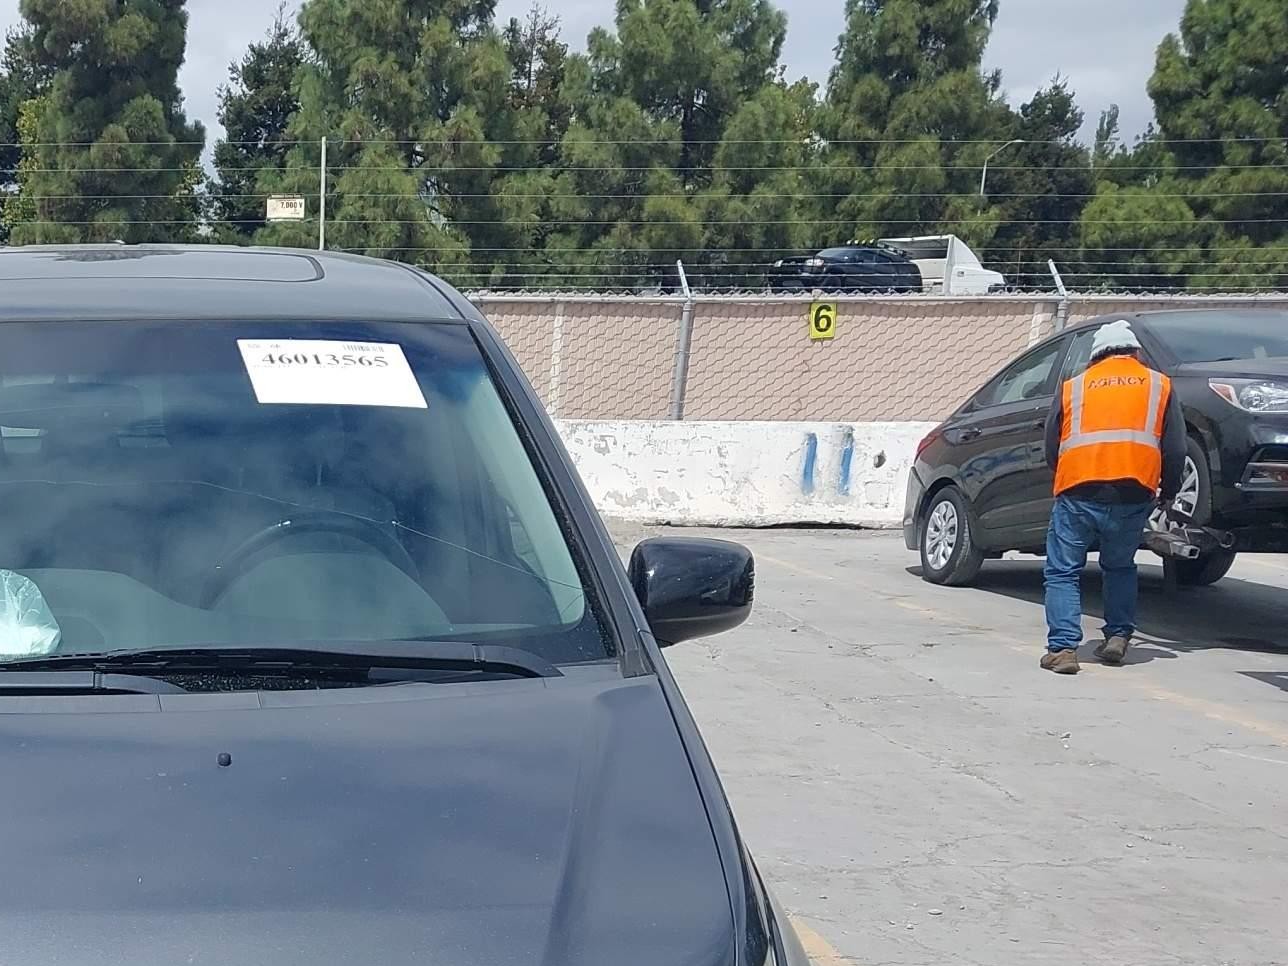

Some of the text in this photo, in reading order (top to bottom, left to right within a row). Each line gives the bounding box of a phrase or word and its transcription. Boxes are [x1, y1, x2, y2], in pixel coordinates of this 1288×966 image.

[814, 304, 833, 333] 6
[261, 353, 389, 368] 46013565
[1087, 376, 1146, 390] AGENCY
